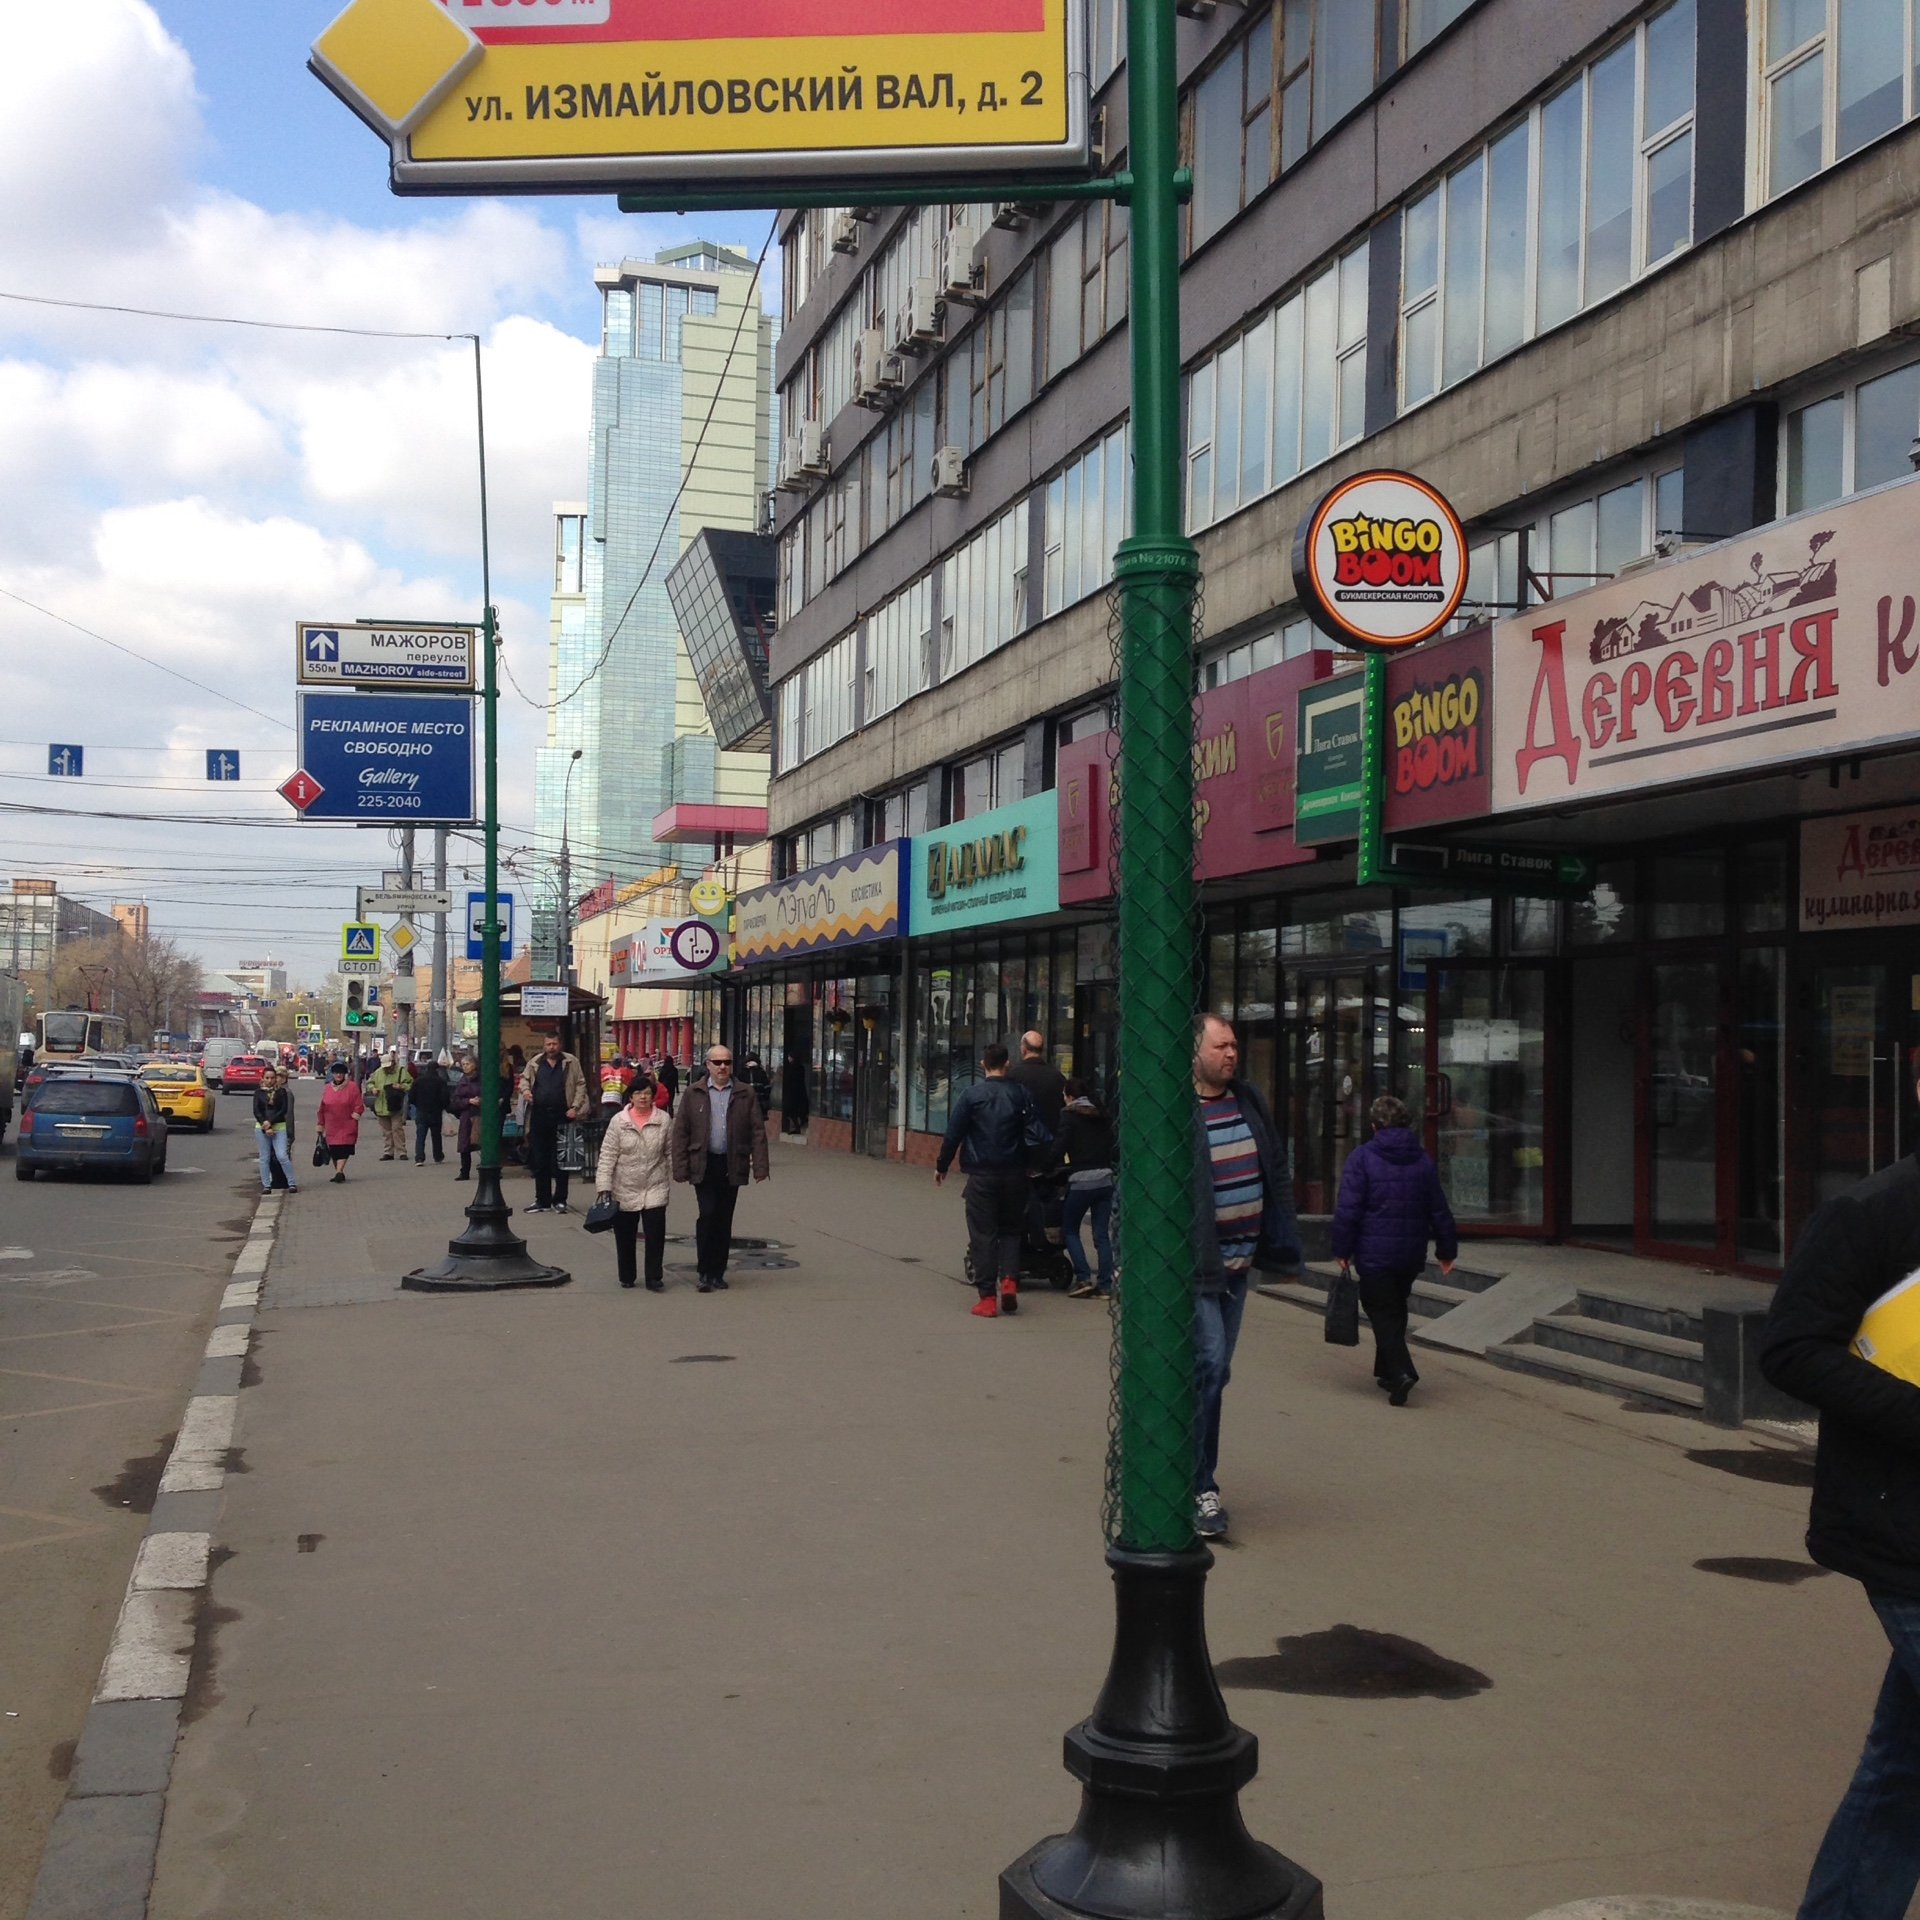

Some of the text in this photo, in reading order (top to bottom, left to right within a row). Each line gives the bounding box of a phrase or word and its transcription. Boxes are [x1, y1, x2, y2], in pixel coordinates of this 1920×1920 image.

[465, 65, 1043, 122] ул. ИЗМАЙЛОВСКИЙ ВАЛ, д. 2
[1336, 550, 1442, 585] BOOM
[1340, 592, 1438, 600] БУКМЕКЕРСКАЯ КОНТОРА
[371, 634, 466, 650] МАЖОРОВ
[406, 652, 466, 664] переулок
[308, 663, 337, 673] 550м
[344, 663, 463, 678] MAZHOROV side-street
[310, 719, 464, 735] РЕКЛАМНОЕ МЕСТО
[343, 741, 433, 757] СВОБОДНО
[1395, 725, 1478, 793] BOOM
[358, 768, 419, 791] Gallery
[357, 795, 421, 808] 225-2040
[1456, 849, 1552, 870] Лига Ставок
[343, 962, 376, 971] СТОП
